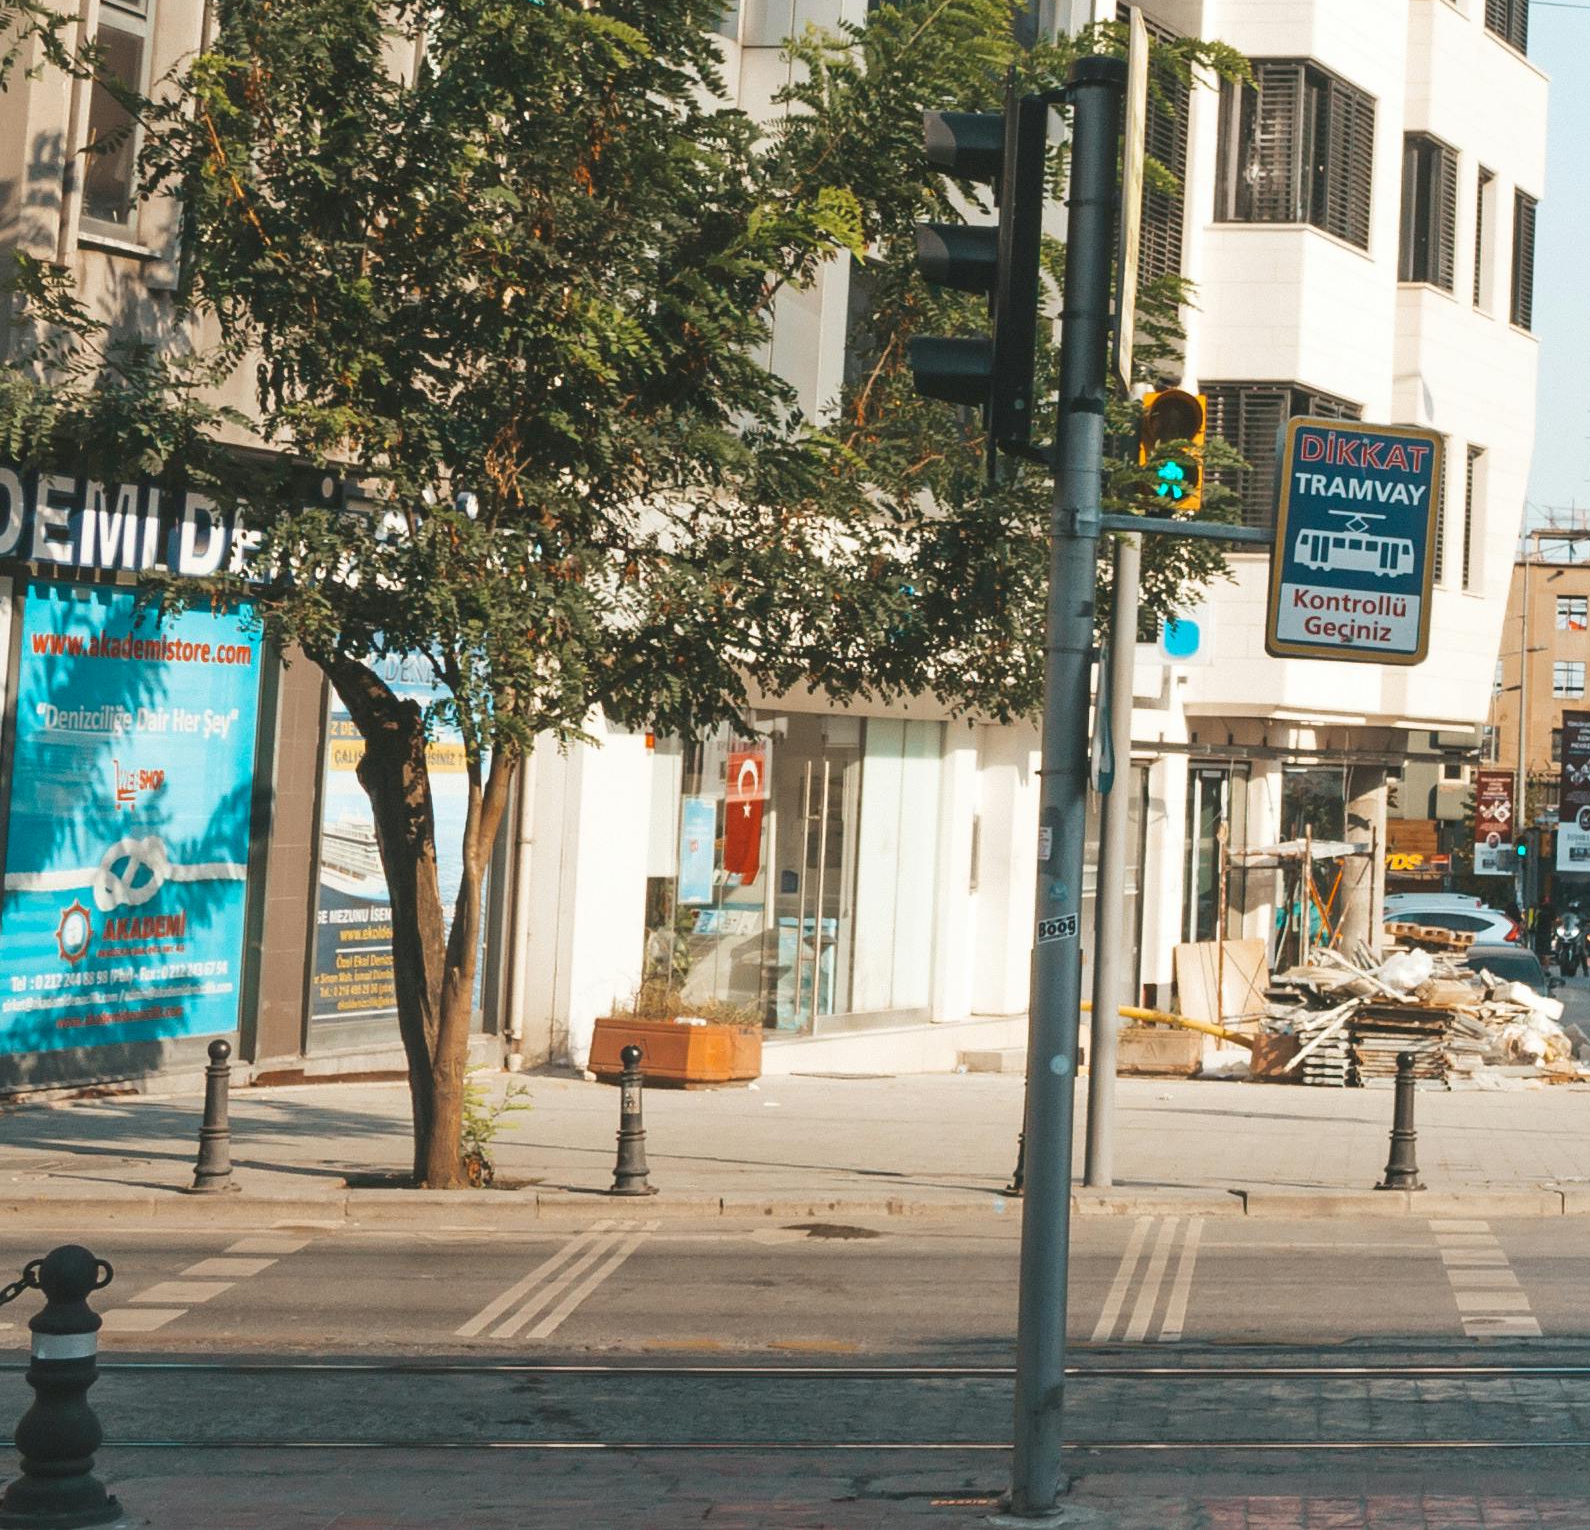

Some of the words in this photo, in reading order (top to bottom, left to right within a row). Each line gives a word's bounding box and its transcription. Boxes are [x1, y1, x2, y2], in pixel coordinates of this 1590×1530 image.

[1300, 431, 1430, 474] DİKKAT
[1295, 472, 1426, 506] TRAMVAY
[1293, 587, 1407, 617] Kontrollü
[1304, 616, 1393, 643] Geçiniz
[32, 630, 252, 665] www.akademistore.com
[137, 707, 169, 732] Dair
[173, 708, 200, 733] Her
